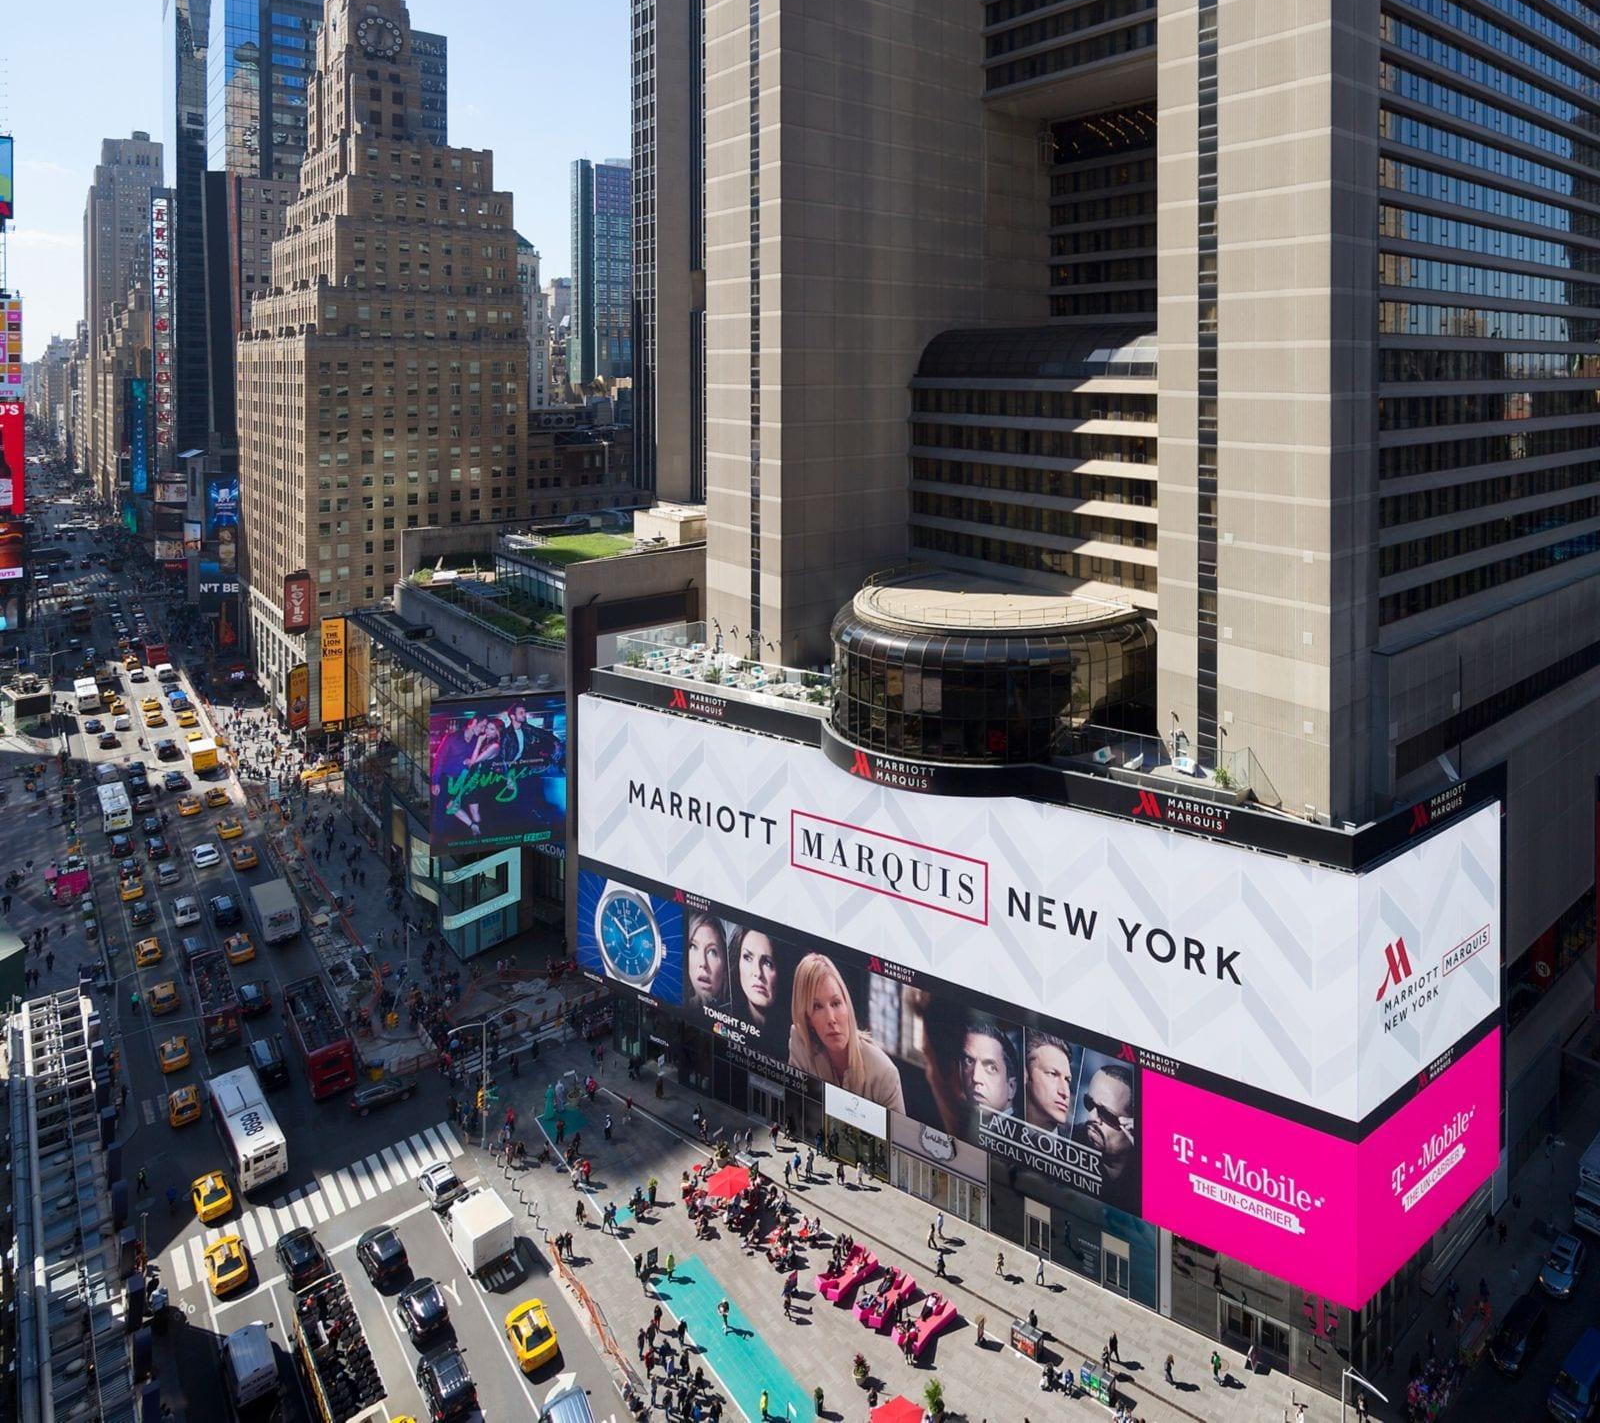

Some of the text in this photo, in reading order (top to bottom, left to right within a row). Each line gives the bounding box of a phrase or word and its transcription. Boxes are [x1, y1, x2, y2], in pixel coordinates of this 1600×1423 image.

[223, 583, 239, 593] BE
[322, 646, 344, 658] KING
[323, 637, 341, 648] LION
[690, 693, 727, 707] MARRIOTT
[690, 702, 722, 715] MARQUIS
[876, 758, 935, 776] MARRIOTT
[876, 771, 928, 788] MARQUIS
[1431, 783, 1466, 807] MARRIOTT
[1167, 798, 1231, 819] MARRIOTT
[1431, 796, 1463, 819] MARQUIS
[1167, 810, 1223, 830] MARQUIS
[628, 780, 1241, 985] MARRIOTT MARQUIS NEW YORK
[884, 962, 916, 977] MARRIOTT
[884, 968, 912, 983] MARQUIS
[1384, 931, 1488, 1014] MARRIOTT MARQUIS
[1384, 985, 1439, 1033] NEW YORK
[703, 1006, 761, 1037] TONIGHT 9/8c
[727, 1029, 746, 1045] NBC
[1140, 1050, 1180, 1069] MARRIOTT
[1140, 1058, 1175, 1076] MARQUIS
[757, 1064, 790, 1083] OCTOBER
[240, 1111, 264, 1137] 6698
[980, 1109, 1102, 1176] LAW & ORDER
[979, 1133, 1102, 1196] SPECIAL VICTIMS UNIT
[1195, 1179, 1292, 1227] THE UN-CARRIER
[1405, 1188, 1421, 1208] THE
